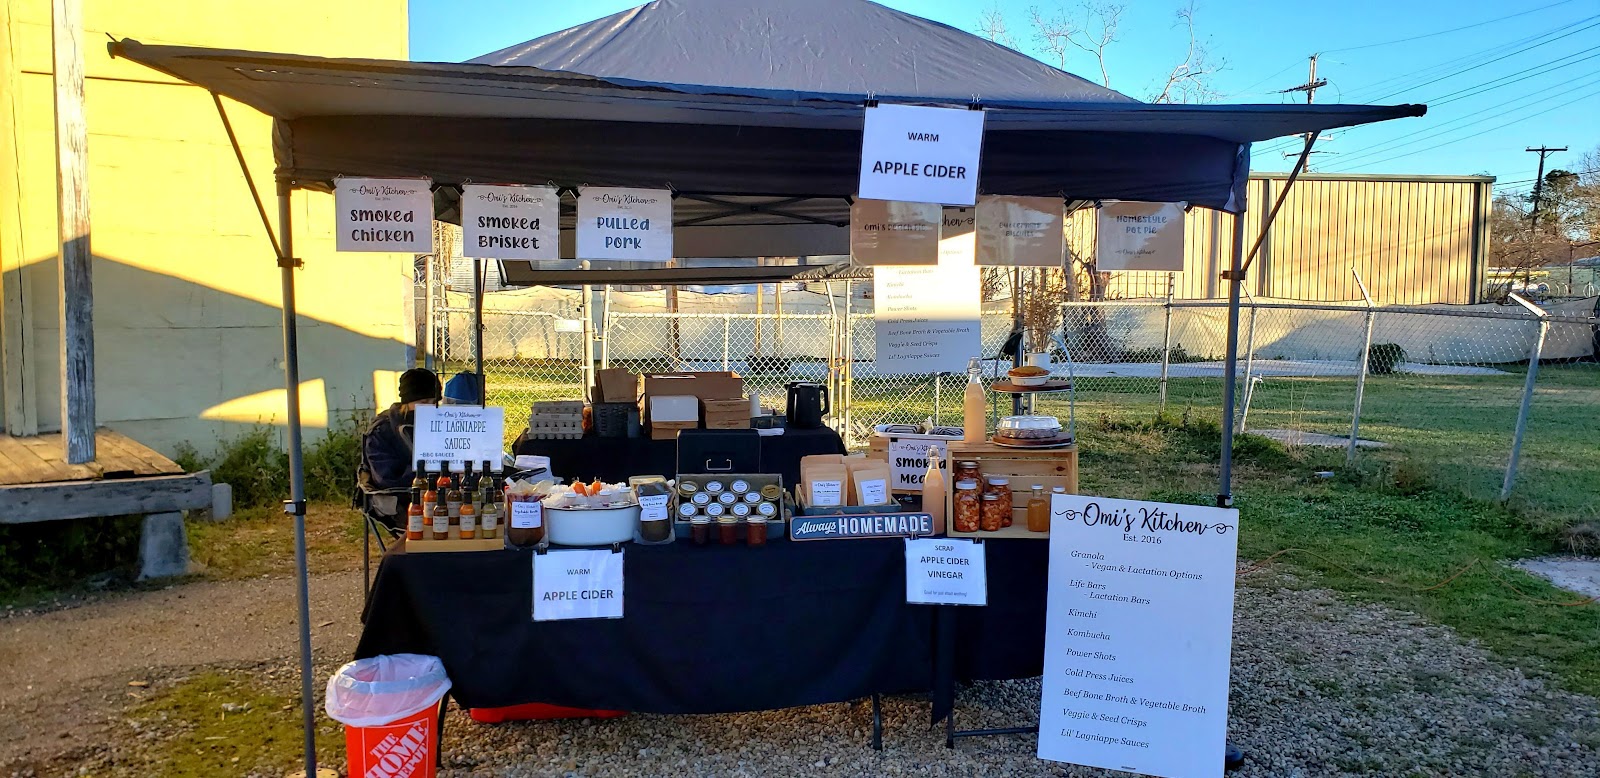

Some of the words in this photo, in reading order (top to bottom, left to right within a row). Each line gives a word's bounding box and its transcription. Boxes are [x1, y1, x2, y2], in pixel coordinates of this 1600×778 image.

[907, 131, 939, 142] WARM
[872, 160, 919, 176] APPLE
[923, 164, 966, 179] CIDER
[446, 420, 487, 433] LAGNIAPPE
[444, 437, 471, 450] SAUCES
[895, 457, 947, 470] Smokd
[795, 521, 837, 535] Always
[838, 515, 929, 535] HOMEMADE
[1083, 502, 1135, 533] Omi's
[1138, 507, 1208, 535] Kitchen
[1122, 533, 1138, 543] Est.
[1140, 535, 1162, 544] 2016
[920, 556, 945, 564] APPLE
[946, 557, 970, 566] CIDER
[1070, 550, 1105, 561] Granola
[927, 570, 963, 580] VINEGAR
[1091, 562, 1117, 572] Vegan
[1118, 564, 1126, 572] &
[1127, 565, 1167, 577] Lactation
[1169, 569, 1203, 581] Options
[1069, 579, 1085, 589] Life
[1086, 581, 1107, 590] Bars
[542, 590, 578, 601] APPLE
[581, 589, 614, 600] CIDER
[1089, 591, 1129, 603] Lactation
[1130, 595, 1151, 605] Bars
[1067, 608, 1098, 619] Kimchi
[1066, 628, 1111, 641] Kombucha
[1066, 648, 1092, 658] Power
[1093, 651, 1116, 662] Shots
[1065, 667, 1083, 677] Cold
[1085, 670, 1107, 681] Press
[1107, 673, 1134, 684] Juices
[1063, 687, 1082, 698] Beef
[1082, 690, 1103, 701] Bone
[1105, 693, 1129, 704] Broth
[1129, 696, 1138, 705] &
[1139, 697, 1180, 711] Vegetable
[1181, 703, 1206, 714] Broth
[1062, 708, 1090, 720] Veggie
[1091, 712, 1098, 720] &
[1099, 713, 1119, 723] Seed
[1120, 715, 1148, 728] Crisps
[1060, 728, 1074, 737] Lil'
[1075, 731, 1119, 745] Lagniappe
[1120, 737, 1149, 748] Sauces
[370, 733, 400, 759] THE
[390, 742, 427, 778] EPOT
